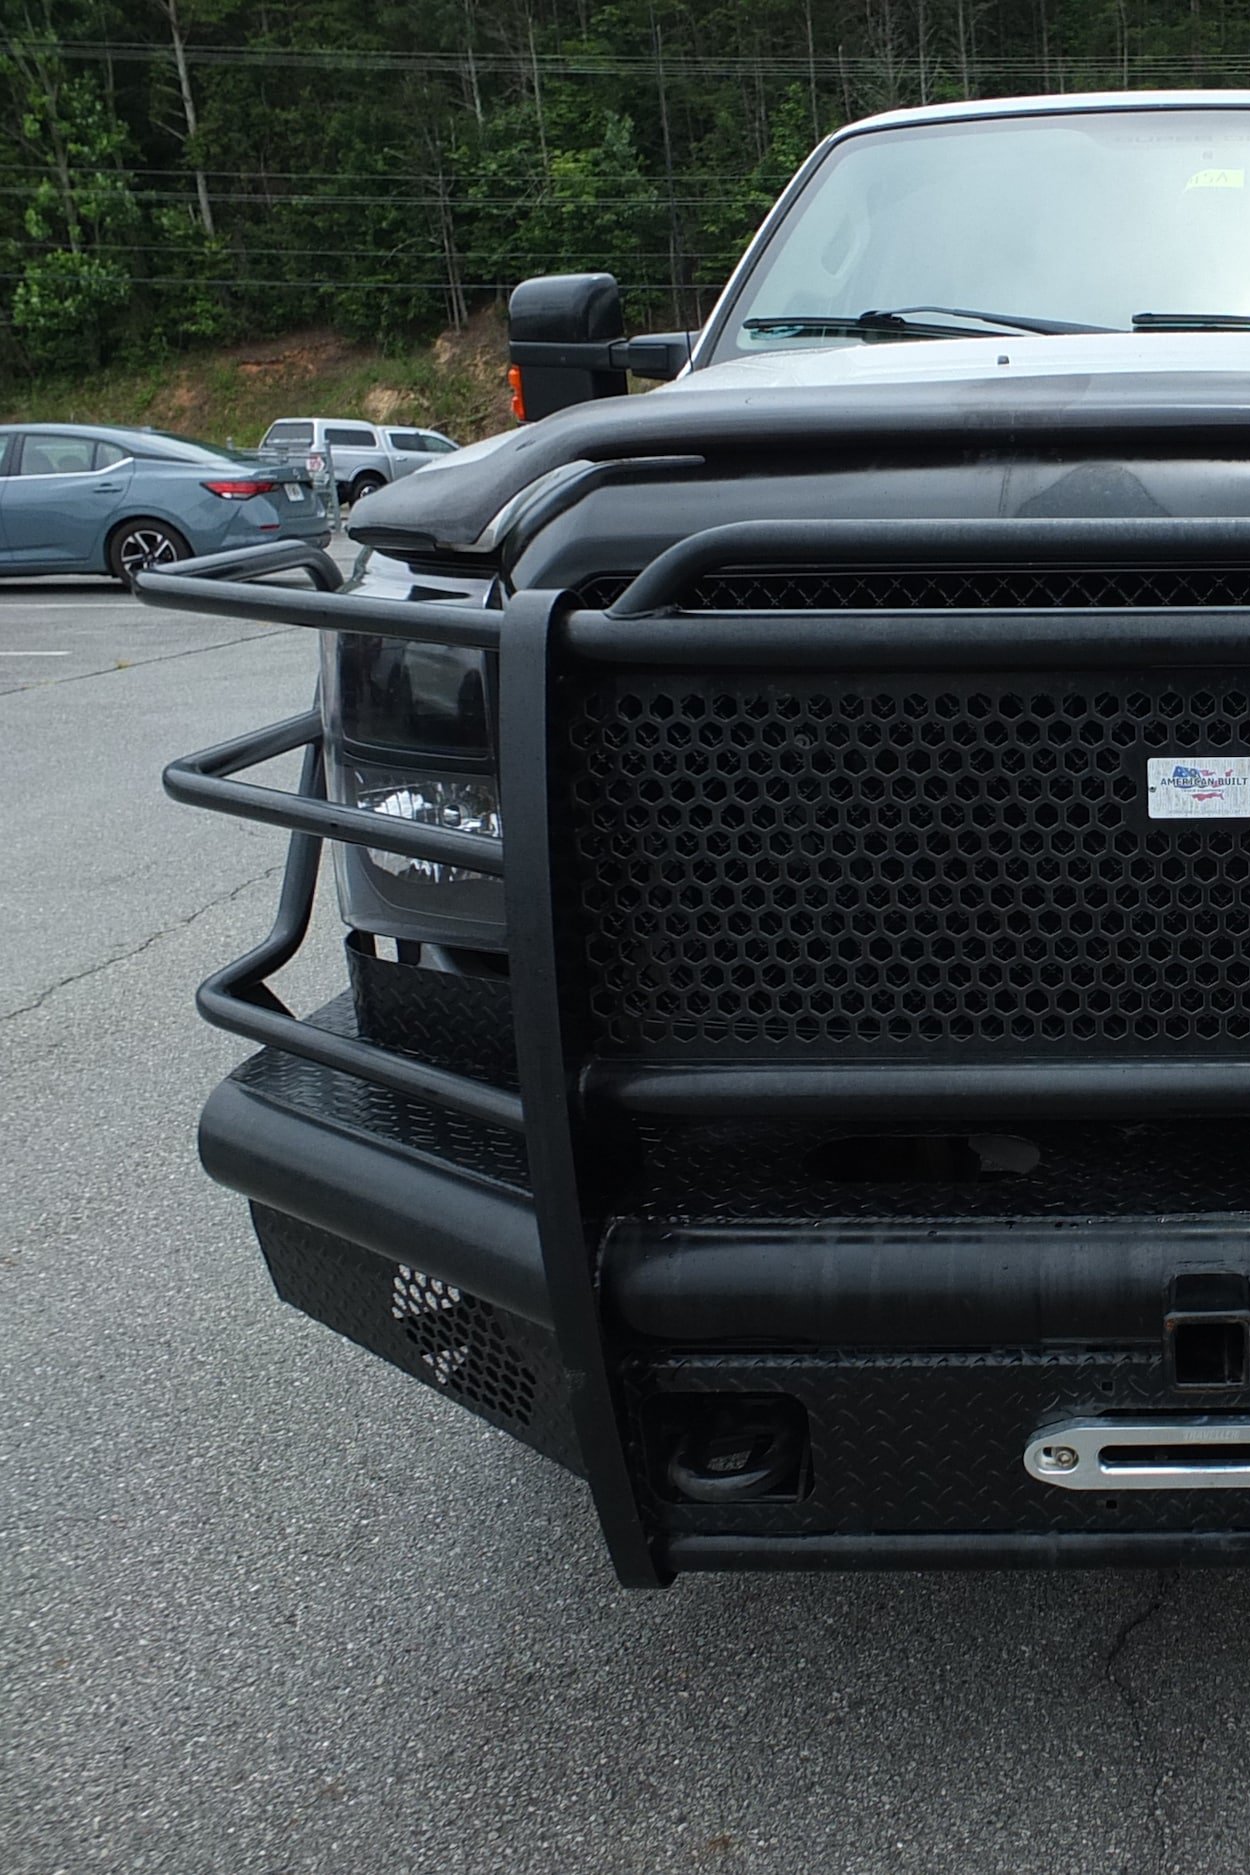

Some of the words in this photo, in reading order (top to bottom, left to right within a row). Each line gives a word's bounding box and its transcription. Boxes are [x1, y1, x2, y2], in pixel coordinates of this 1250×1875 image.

[1160, 778, 1215, 786] AMERICAN
[1217, 777, 1249, 786] BUILT
[1183, 1430, 1241, 1441] TRAVELLER
